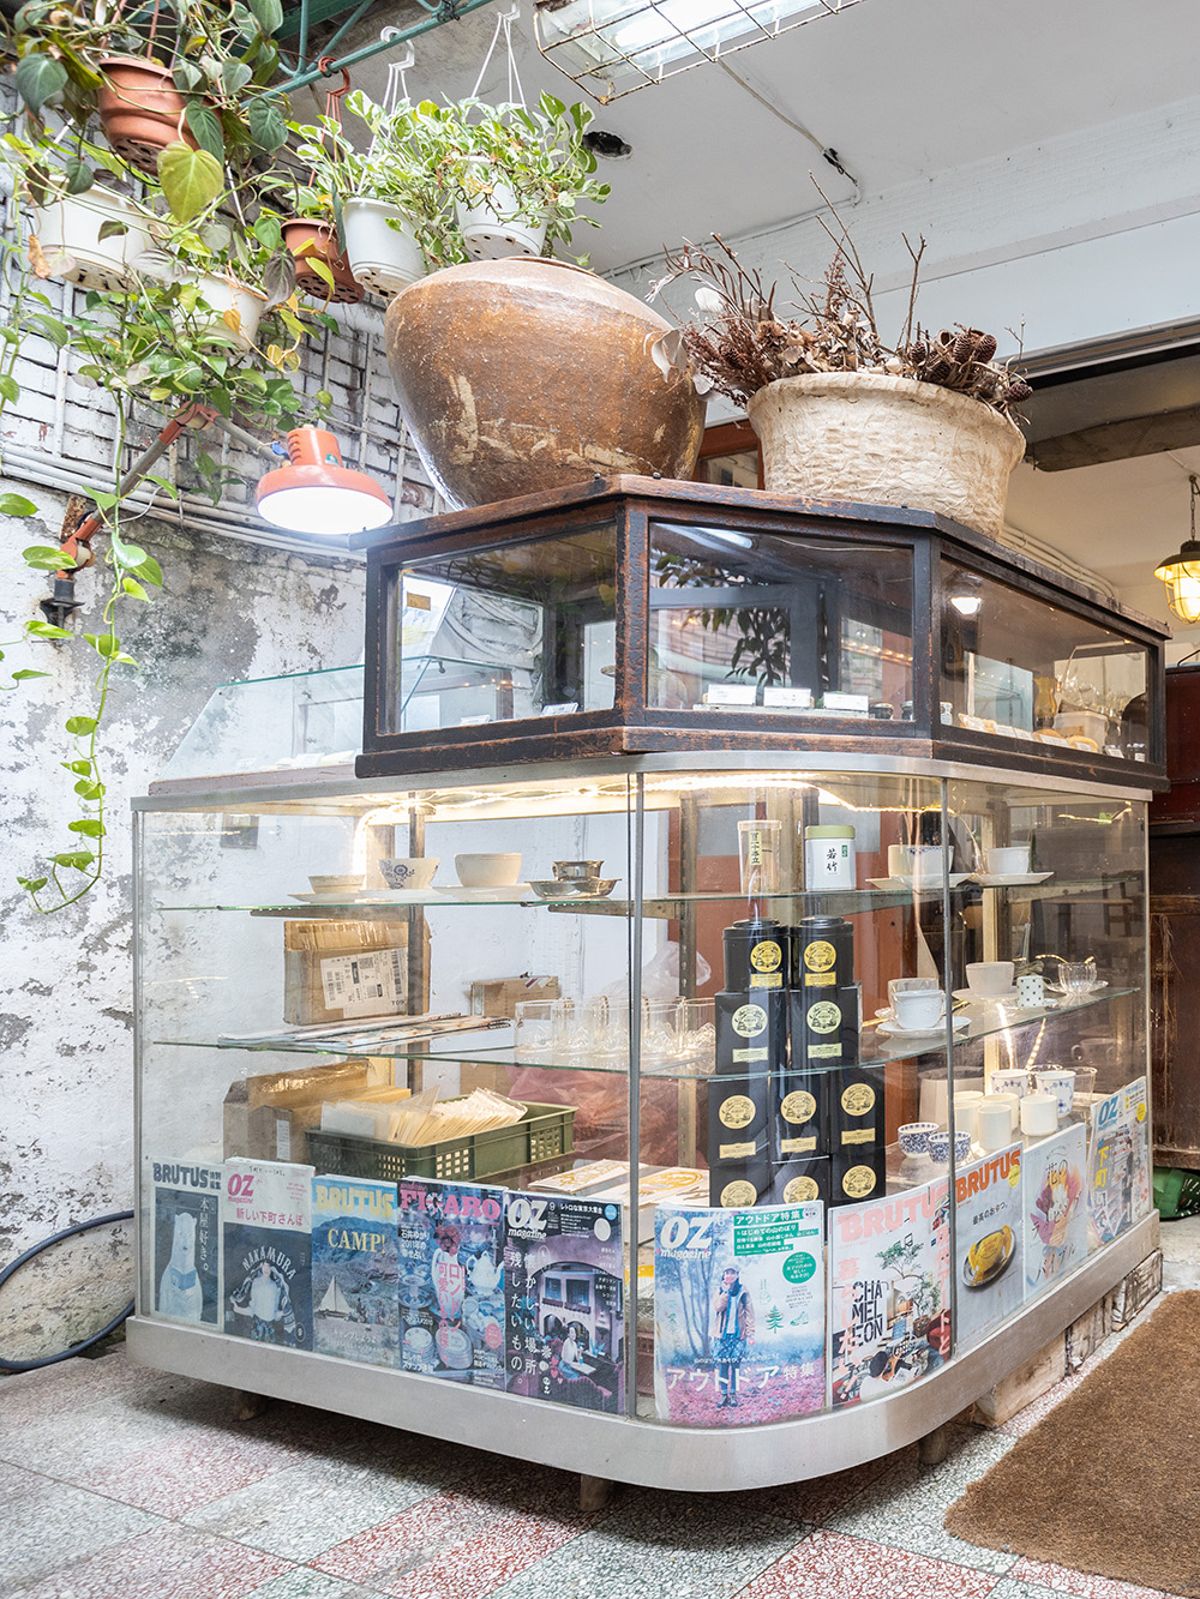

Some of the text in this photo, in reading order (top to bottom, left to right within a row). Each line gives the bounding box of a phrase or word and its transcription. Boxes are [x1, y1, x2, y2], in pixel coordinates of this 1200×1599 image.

[1098, 1096, 1119, 1126] OZ
[153, 1163, 209, 1189] BRUTUS
[227, 1173, 255, 1197] OZ
[956, 1149, 1021, 1203] BRUTUS
[316, 1184, 396, 1218] BRUTUS
[401, 1190, 501, 1220] FIGARO
[508, 1198, 548, 1231] OZ
[236, 1207, 304, 1227] 新しい下町さんぽ
[736, 1211, 801, 1225] アウトドア特集
[328, 1228, 387, 1254] CAMP!
[508, 1229, 547, 1240] magazine
[660, 1216, 713, 1250] OZ
[242, 1246, 297, 1280] NAKAMURA
[852, 1279, 883, 1303] CHA
[510, 1251, 523, 1385] 残したいもの。
[851, 1300, 883, 1324] MEL
[667, 1363, 815, 1392] アウトドア特集
